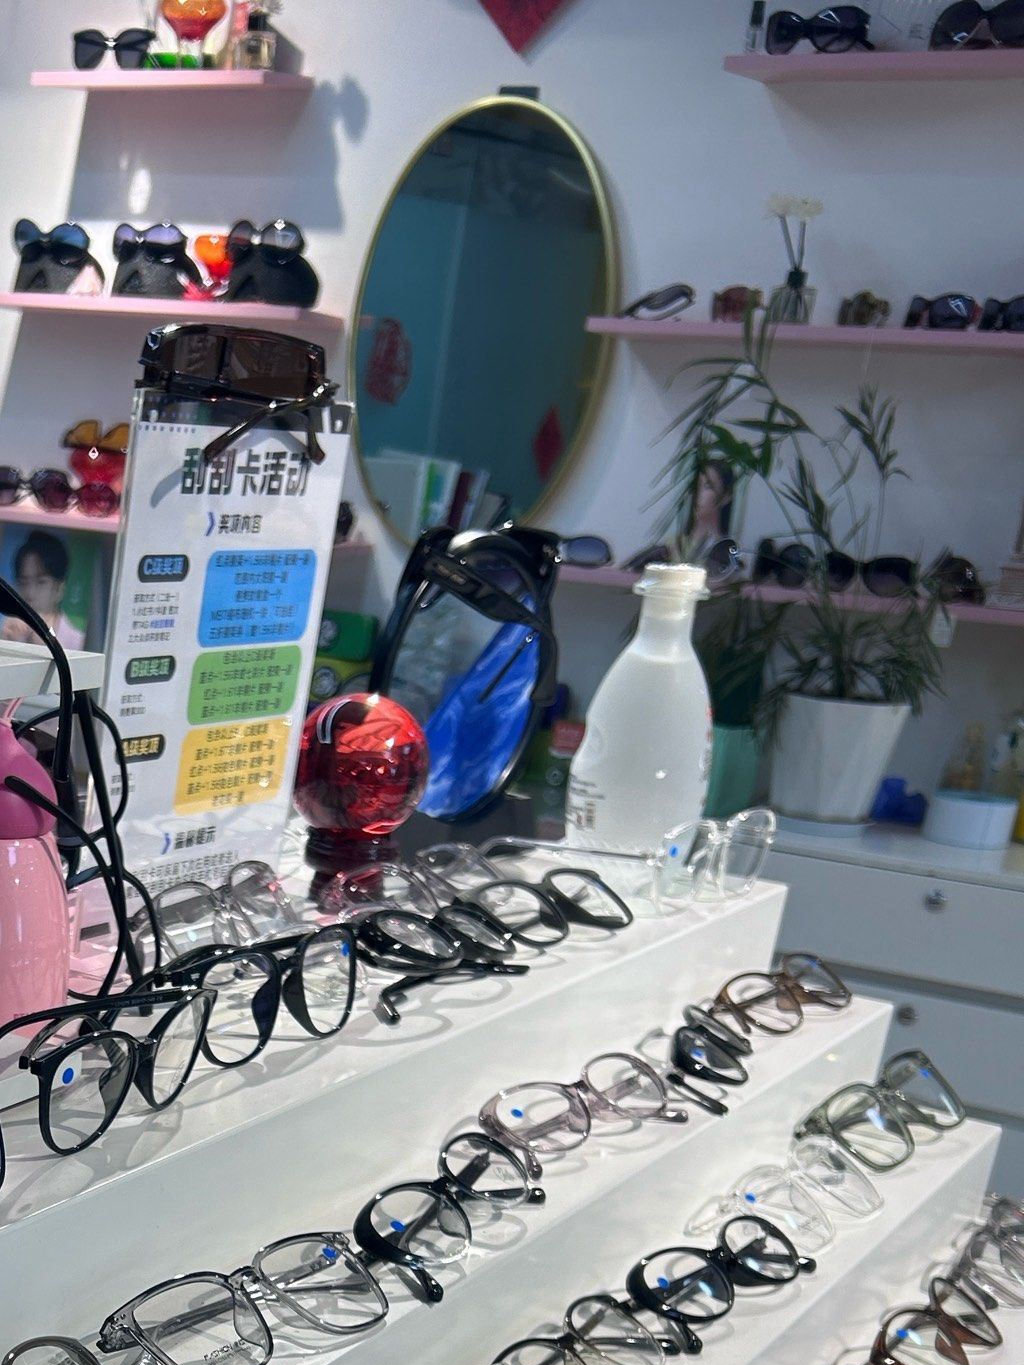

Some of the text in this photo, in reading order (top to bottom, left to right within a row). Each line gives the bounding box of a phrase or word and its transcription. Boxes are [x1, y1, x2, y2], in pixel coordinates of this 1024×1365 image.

[181, 447, 311, 496] 刮刮卡活动
[218, 515, 262, 534] 奖项内容
